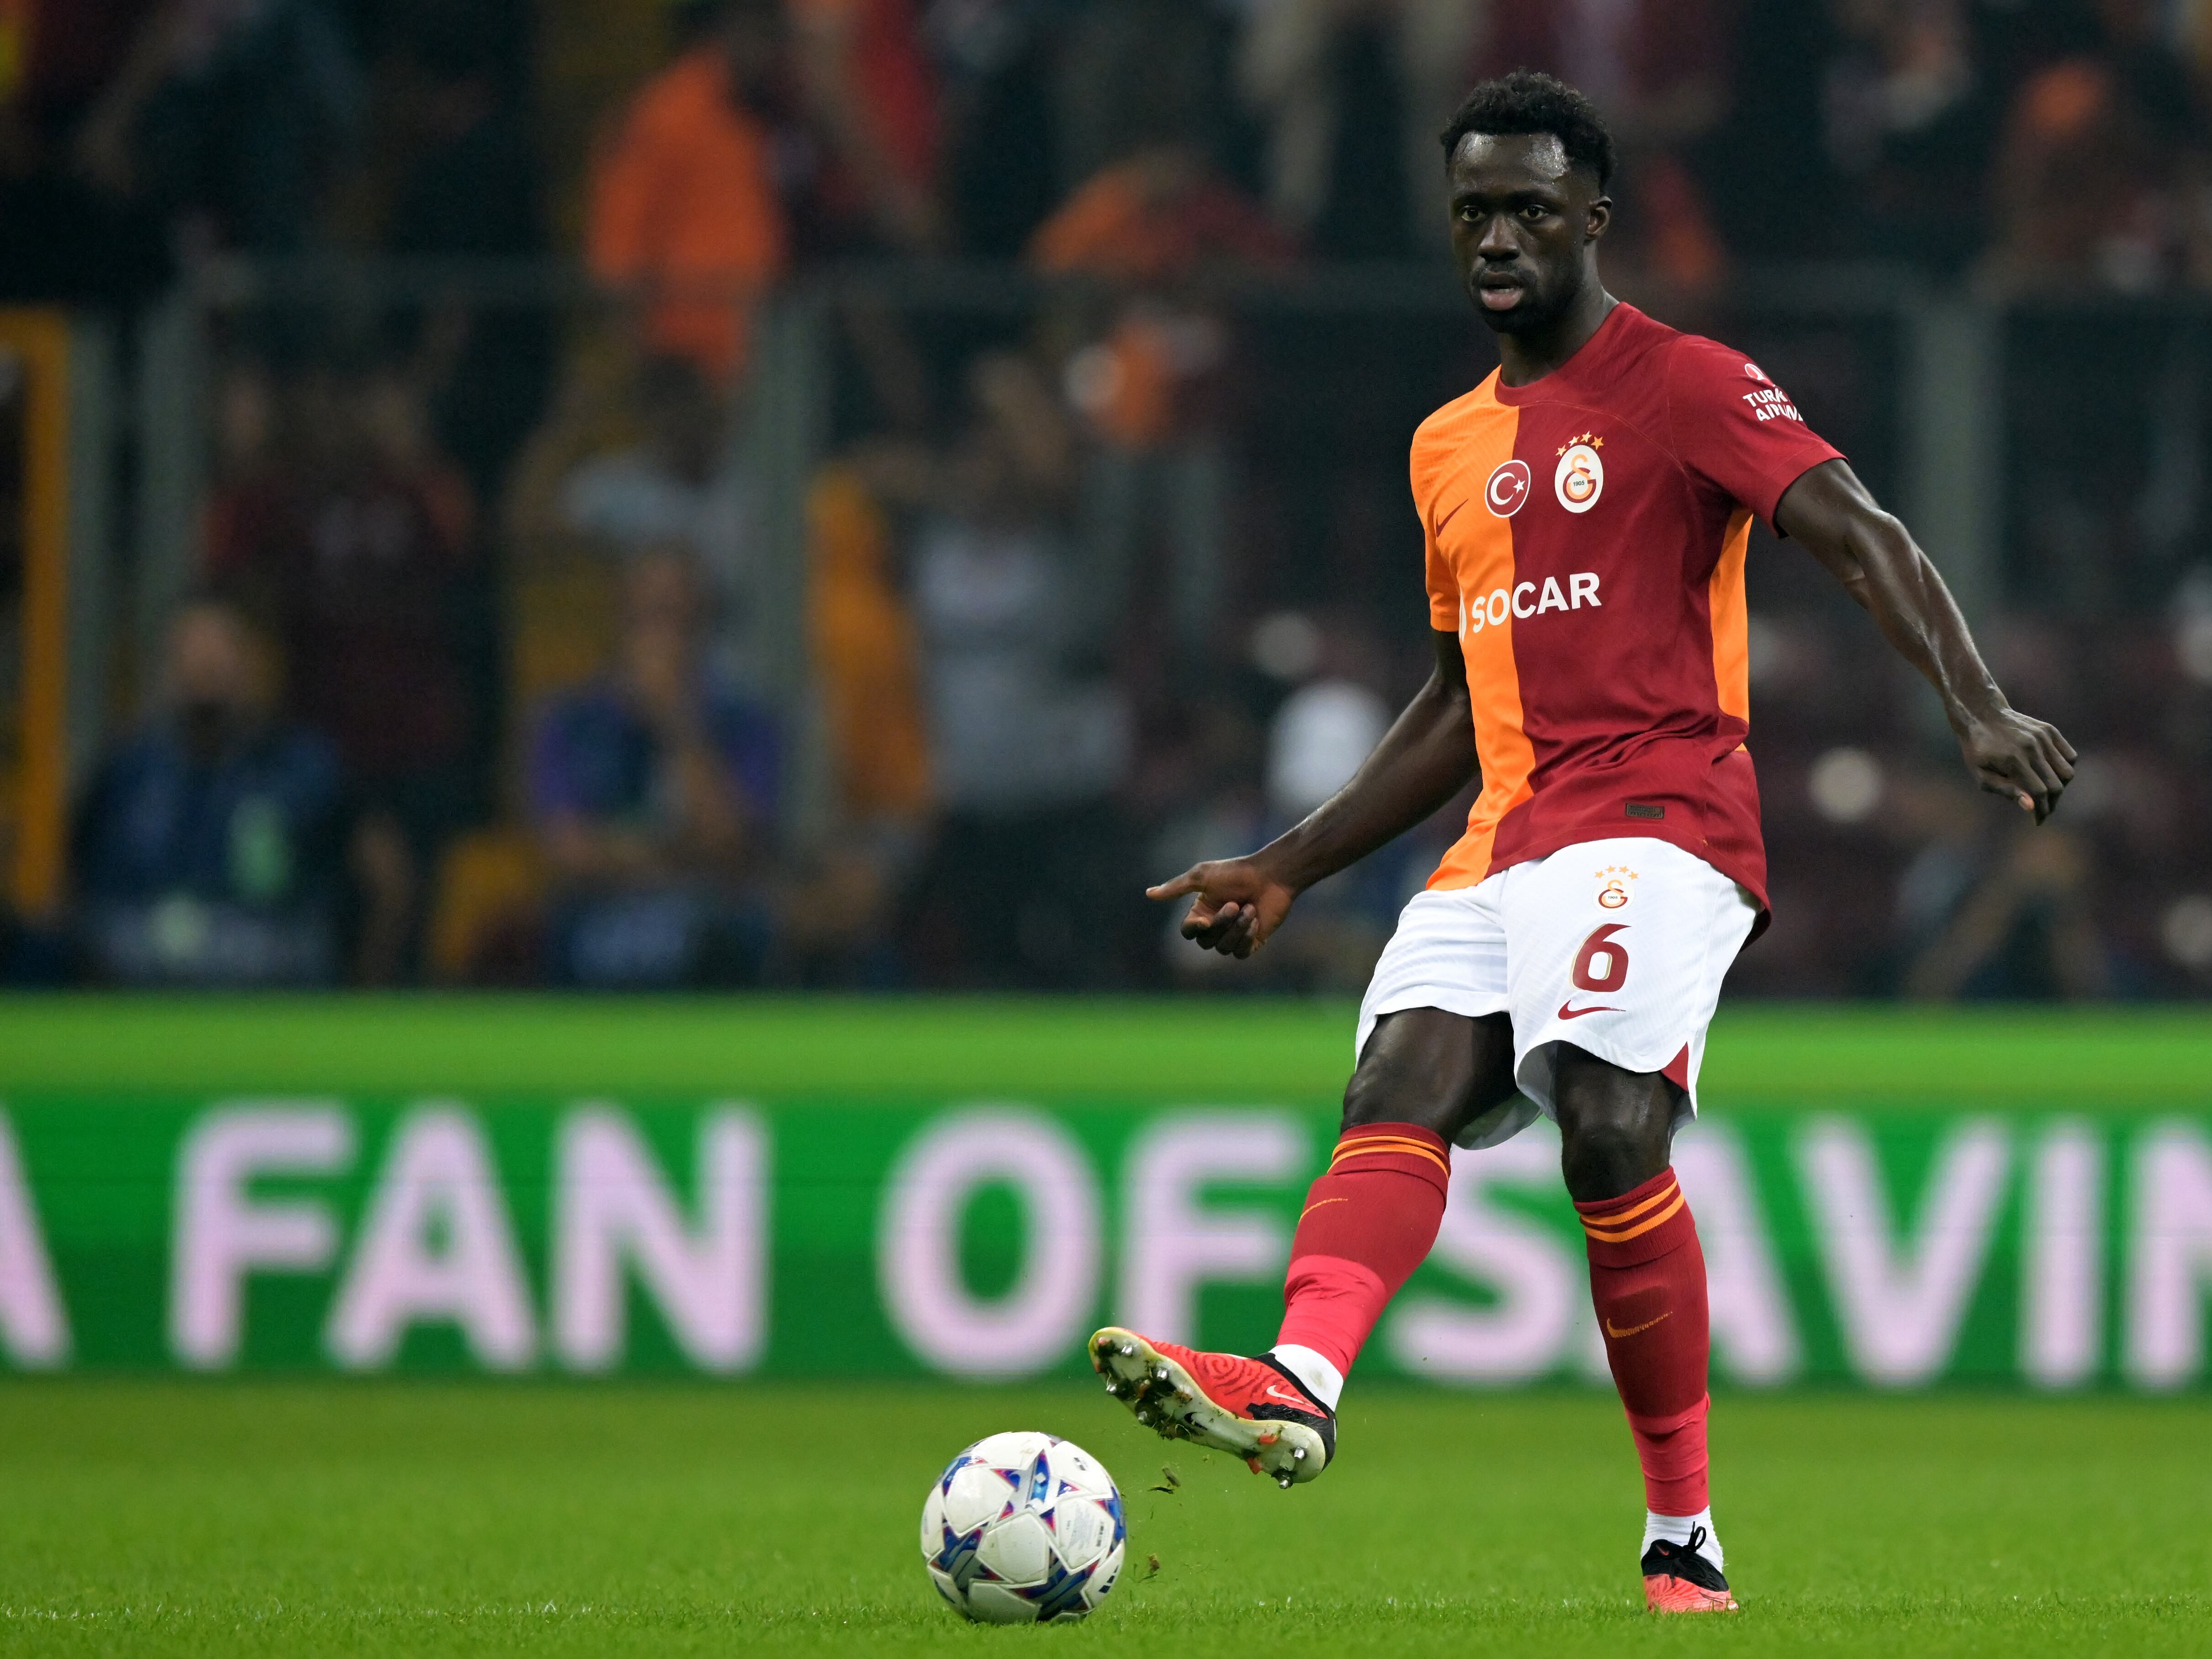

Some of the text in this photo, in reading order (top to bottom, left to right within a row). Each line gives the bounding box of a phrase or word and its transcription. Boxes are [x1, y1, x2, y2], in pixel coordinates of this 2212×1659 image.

[1742, 388, 1788, 407] TURK
[1472, 572, 1602, 633] SOCAR
[1569, 923, 1632, 993] 6
[169, 1103, 773, 1370] FAN
[879, 1103, 1309, 1380] OF
